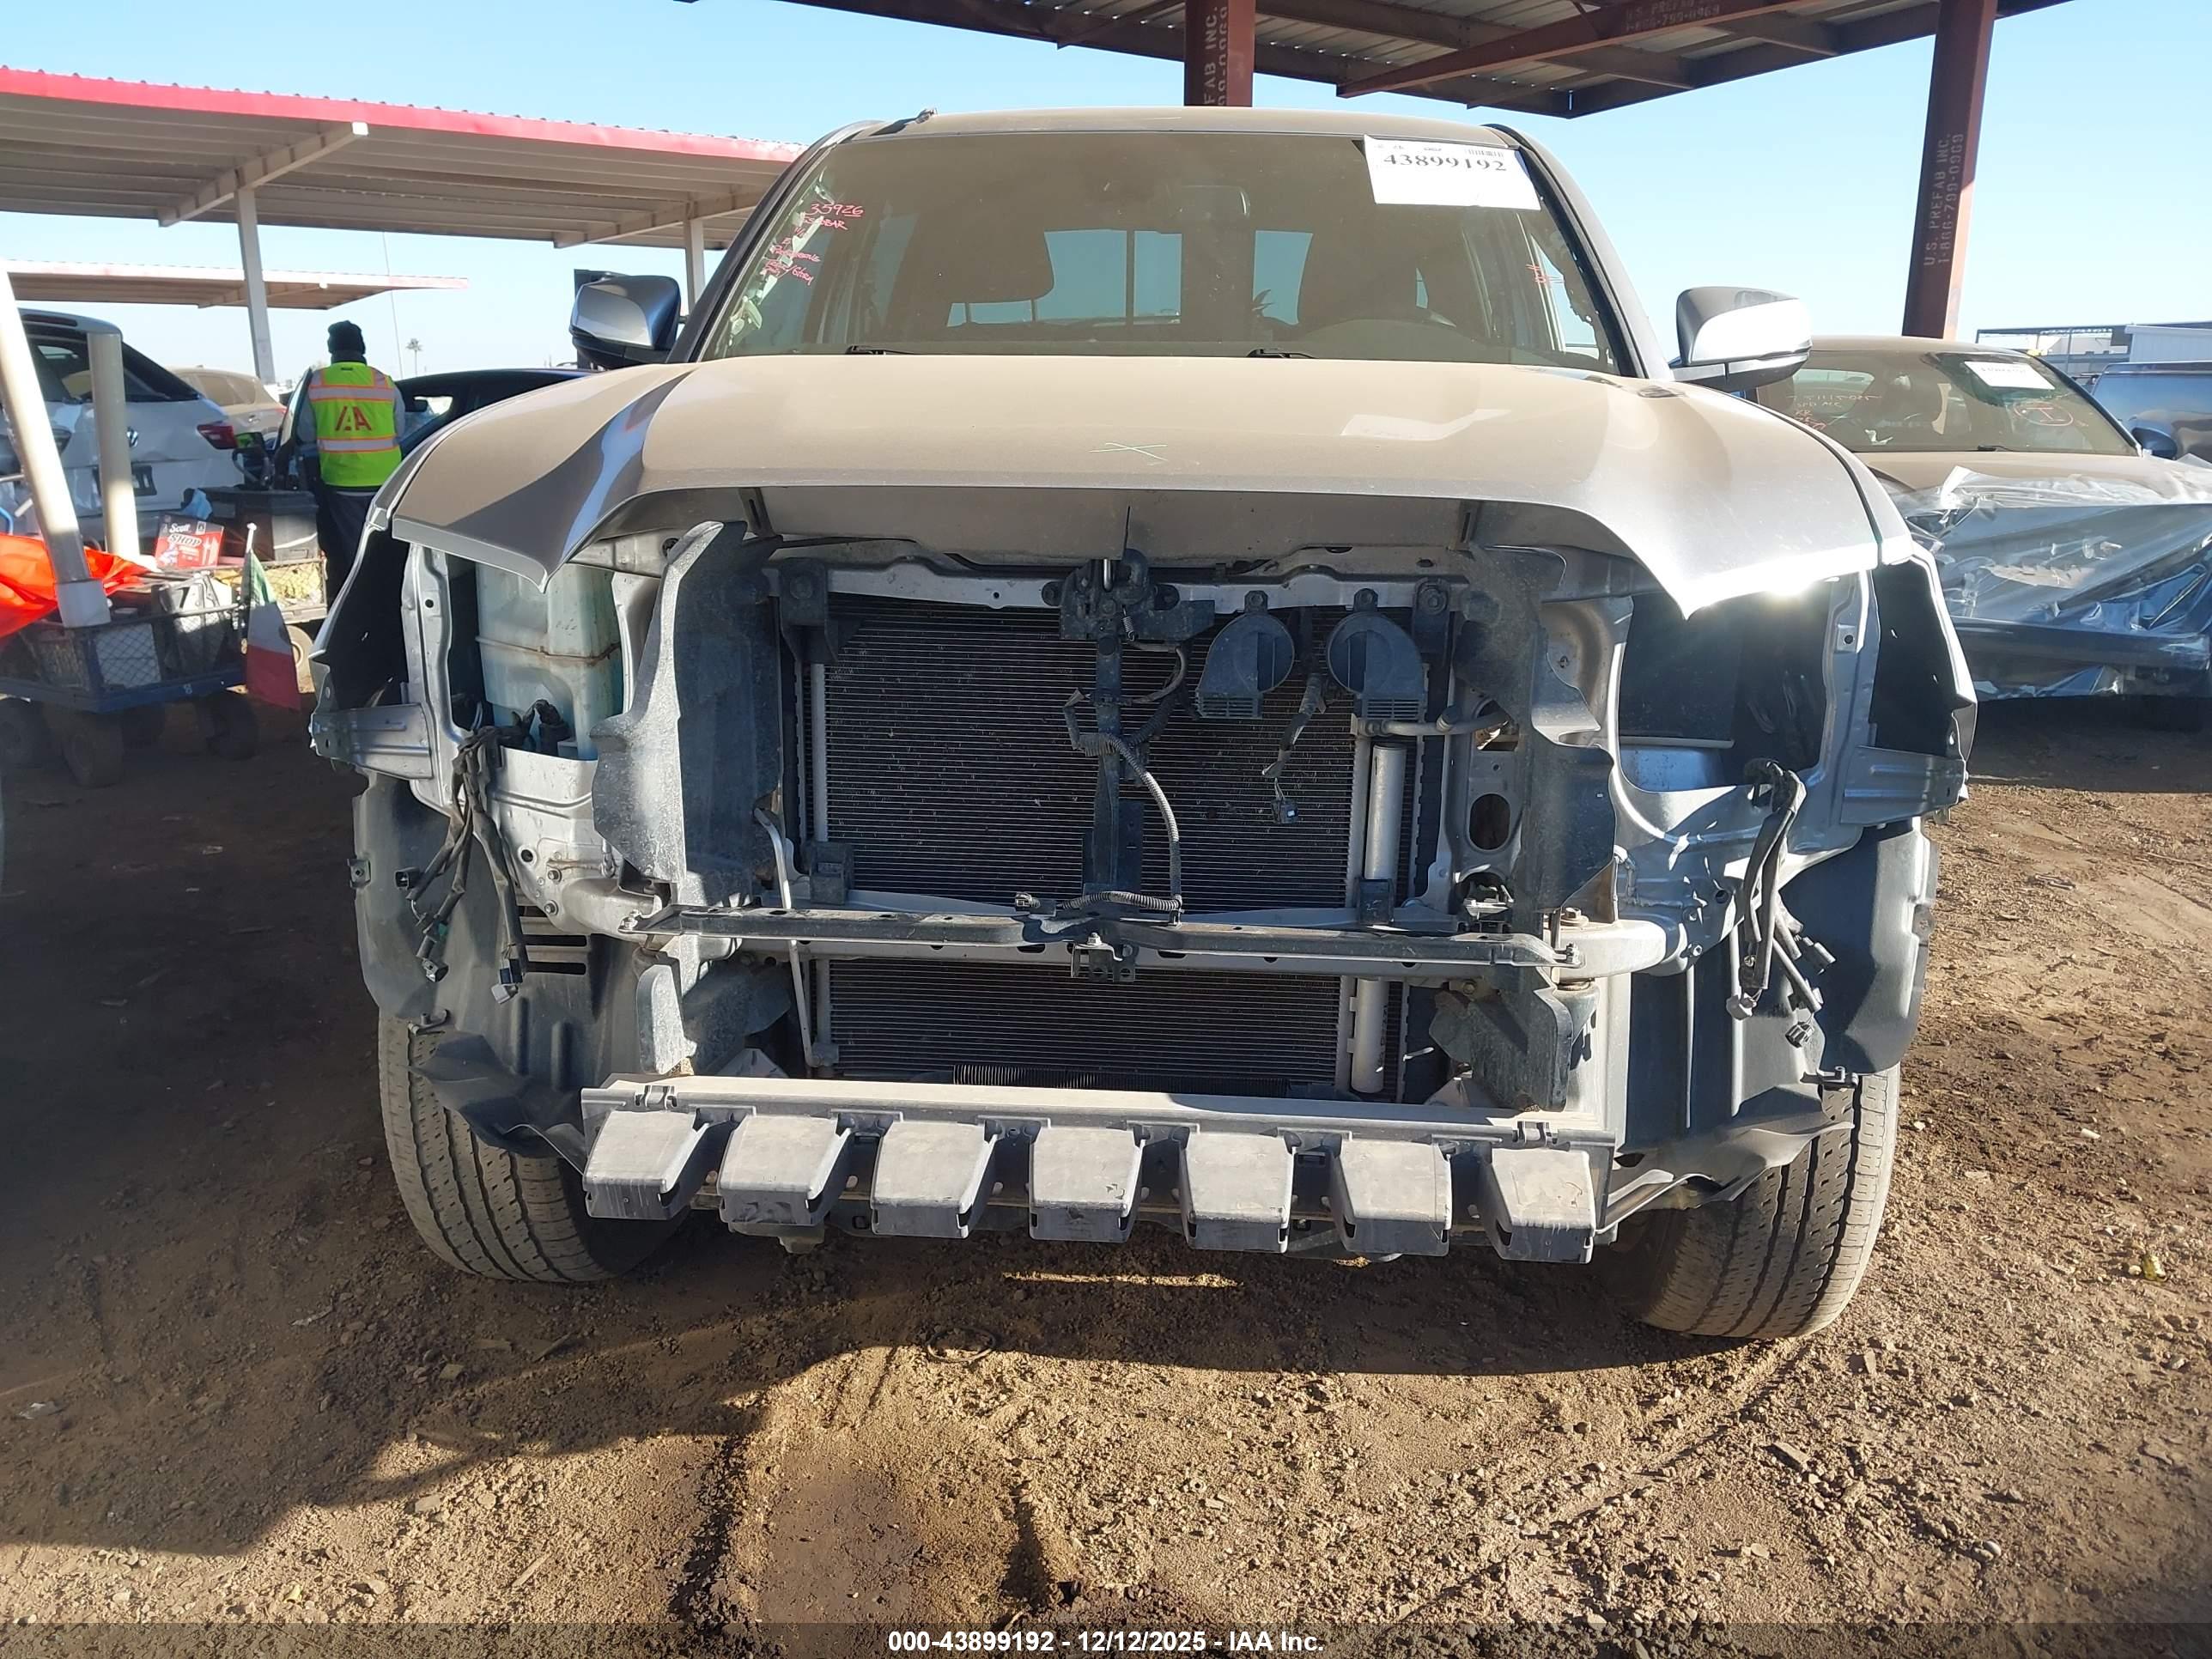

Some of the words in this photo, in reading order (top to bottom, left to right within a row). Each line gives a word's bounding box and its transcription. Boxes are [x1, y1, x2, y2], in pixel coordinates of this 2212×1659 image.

[1205, 6, 1218, 50] INC.
[1937, 133, 1952, 163] INC.
[1383, 154, 1507, 172] 43899192
[1929, 172, 1946, 229] PREFAB
[1923, 237, 1938, 266] U.S.
[169, 522, 191, 533] Scott
[170, 533, 200, 546] SHOP
